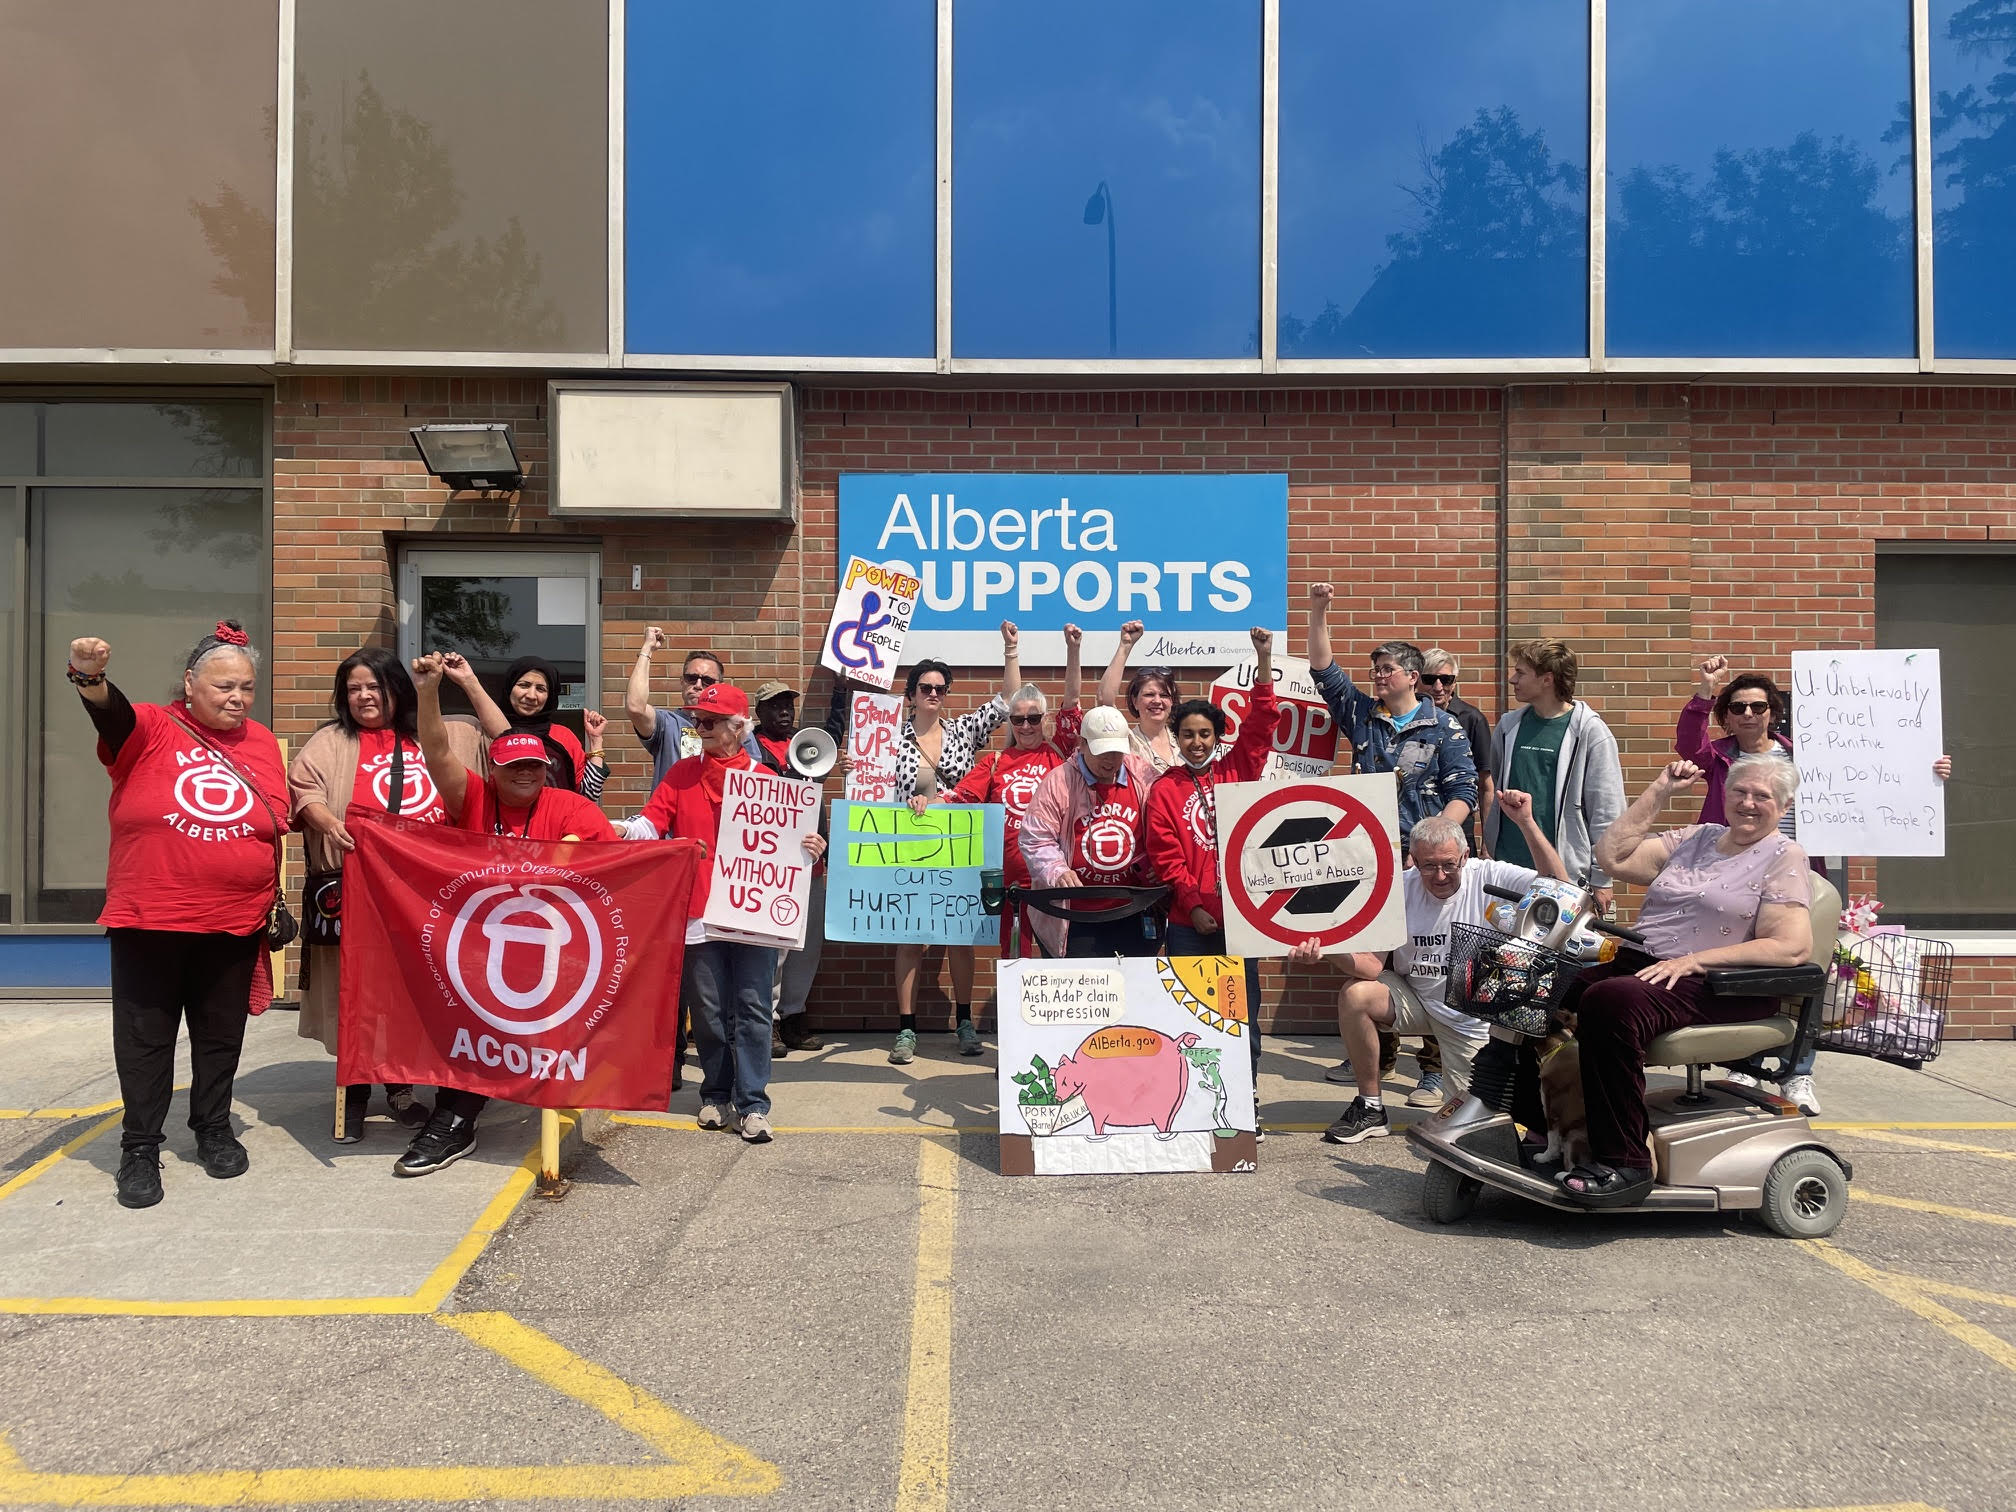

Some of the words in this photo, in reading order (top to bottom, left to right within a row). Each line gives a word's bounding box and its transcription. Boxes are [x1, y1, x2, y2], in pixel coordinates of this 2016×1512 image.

[877, 493, 1118, 552] Alberta
[845, 559, 920, 600] POWER
[888, 596, 911, 615] TO
[890, 615, 909, 633] THE
[865, 632, 901, 652] PEOPLE
[1145, 636, 1208, 657] Alberta
[849, 667, 882, 686] ACORN
[1826, 672, 1929, 721] Unbelievably
[854, 696, 901, 728] Stand
[1221, 692, 1332, 755] SOP
[1826, 705, 1875, 727] Cruel
[1897, 716, 1922, 729] and
[506, 738, 539, 746] ACORN
[855, 727, 891, 757] UP
[1826, 731, 1885, 751] Punitive
[1843, 765, 1868, 781] Do
[1872, 764, 1901, 785] You
[729, 773, 816, 807] NOTHING
[851, 785, 885, 802] UCP
[1801, 792, 1857, 806] HATE
[162, 811, 256, 842] ALBERTA
[731, 801, 804, 829] ABOUT
[1081, 802, 1138, 827] ACORN
[1800, 810, 1865, 825] Disabled
[742, 828, 779, 855] US
[856, 808, 972, 867] AISH
[1271, 843, 1330, 868] UCP
[439, 862, 515, 900] Community
[718, 854, 803, 893] WITHOUT
[1247, 873, 1275, 887] Waste
[1283, 867, 1314, 885] Fraud
[1325, 865, 1365, 878] Abuse
[429, 900, 444, 920] of
[729, 884, 764, 913] US
[849, 888, 918, 917] HURT
[930, 893, 986, 917] PEOPL
[608, 907, 625, 931] for
[1413, 934, 1447, 946] TRUST
[421, 923, 458, 1007] Association
[603, 935, 629, 996] Reform
[1421, 953, 1441, 962] am
[1022, 974, 1049, 987] WCB
[1050, 975, 1074, 986] injury
[1078, 973, 1110, 986] denial
[1410, 964, 1440, 977] ADAP
[1086, 989, 1118, 1003] claim
[585, 997, 613, 1031] Now
[449, 1028, 588, 1081] ACORN
[1025, 1106, 1057, 1117] PORK
[1031, 1118, 1054, 1130] Barrel
